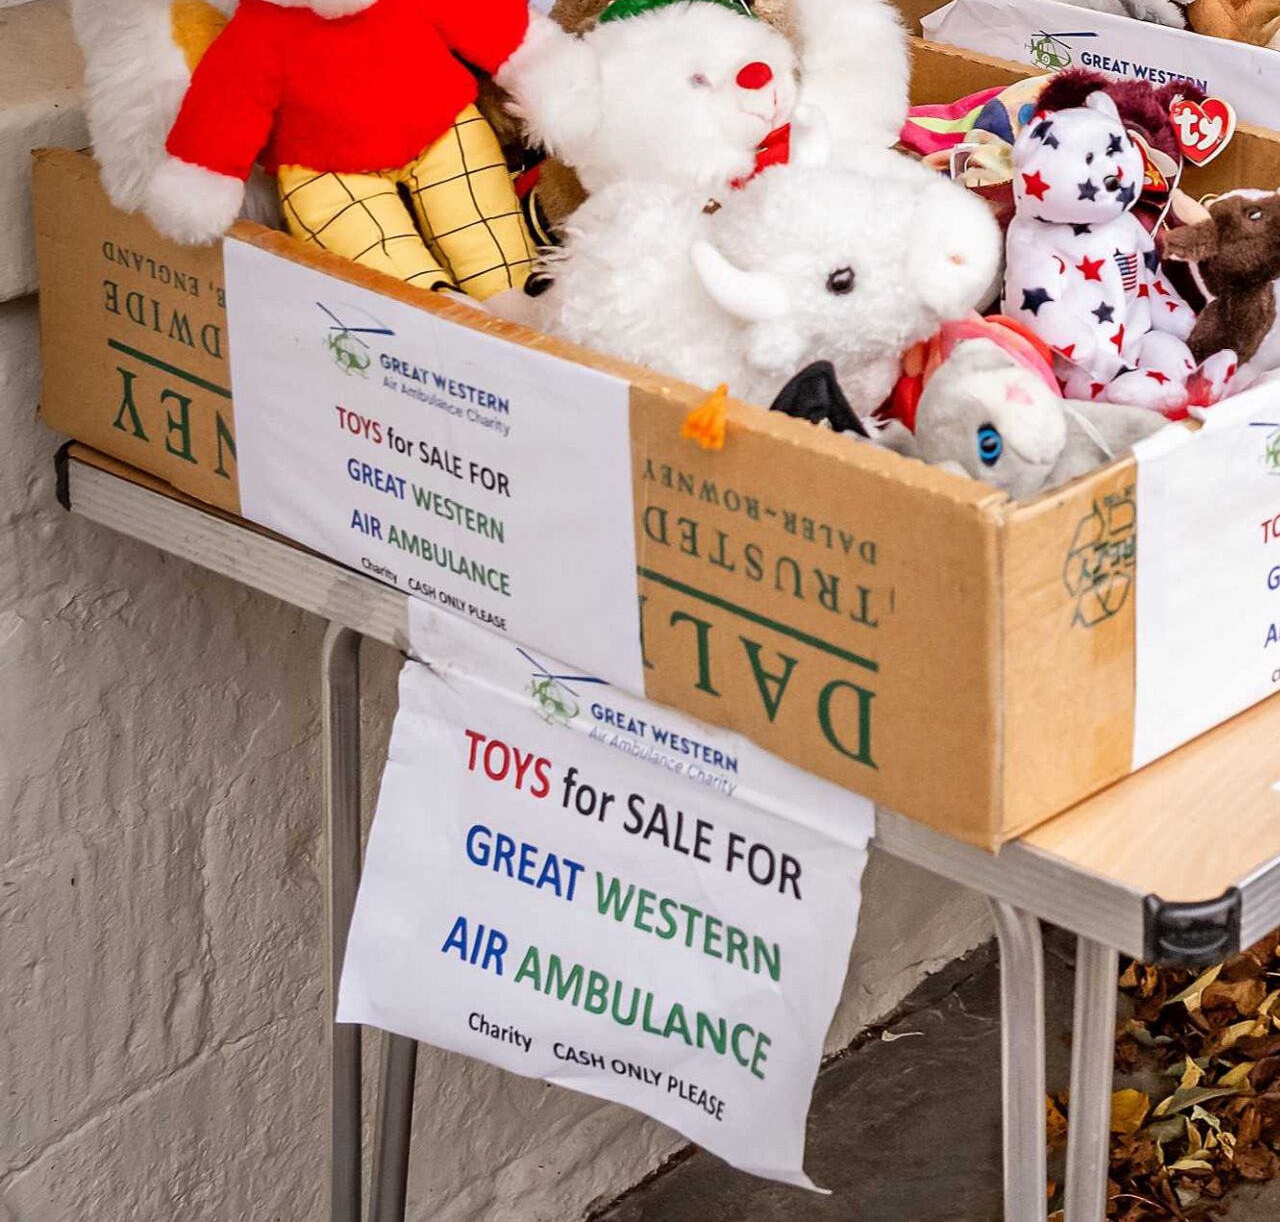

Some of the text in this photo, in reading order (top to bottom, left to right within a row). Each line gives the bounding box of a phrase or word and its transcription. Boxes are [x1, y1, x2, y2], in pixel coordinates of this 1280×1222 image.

[1081, 52, 1208, 94] GREAT WESTN
[103, 241, 200, 297] ENGLAND
[380, 353, 510, 415] GREAT WESTERN
[383, 376, 511, 438] Air Ambulance Charity
[336, 406, 512, 498] TOYS for SALE FOR
[346, 458, 505, 544] GREAT WESTERN
[350, 508, 512, 597] AIR AMBULANCE
[361, 557, 508, 631] Charity CASH ONLY PLEASE
[642, 505, 880, 629] TRUSTED
[639, 595, 880, 772] DAL
[588, 727, 738, 797] Air Ambulance Charity
[591, 703, 739, 774] GREAT WESTERN
[464, 728, 803, 901] TOYS for SALE FOR
[465, 824, 782, 983] GREAT WESTERN
[441, 915, 773, 1081] AIR AMBULANCE
[467, 1011, 726, 1123] Charity CASH ONLY PLEASE
